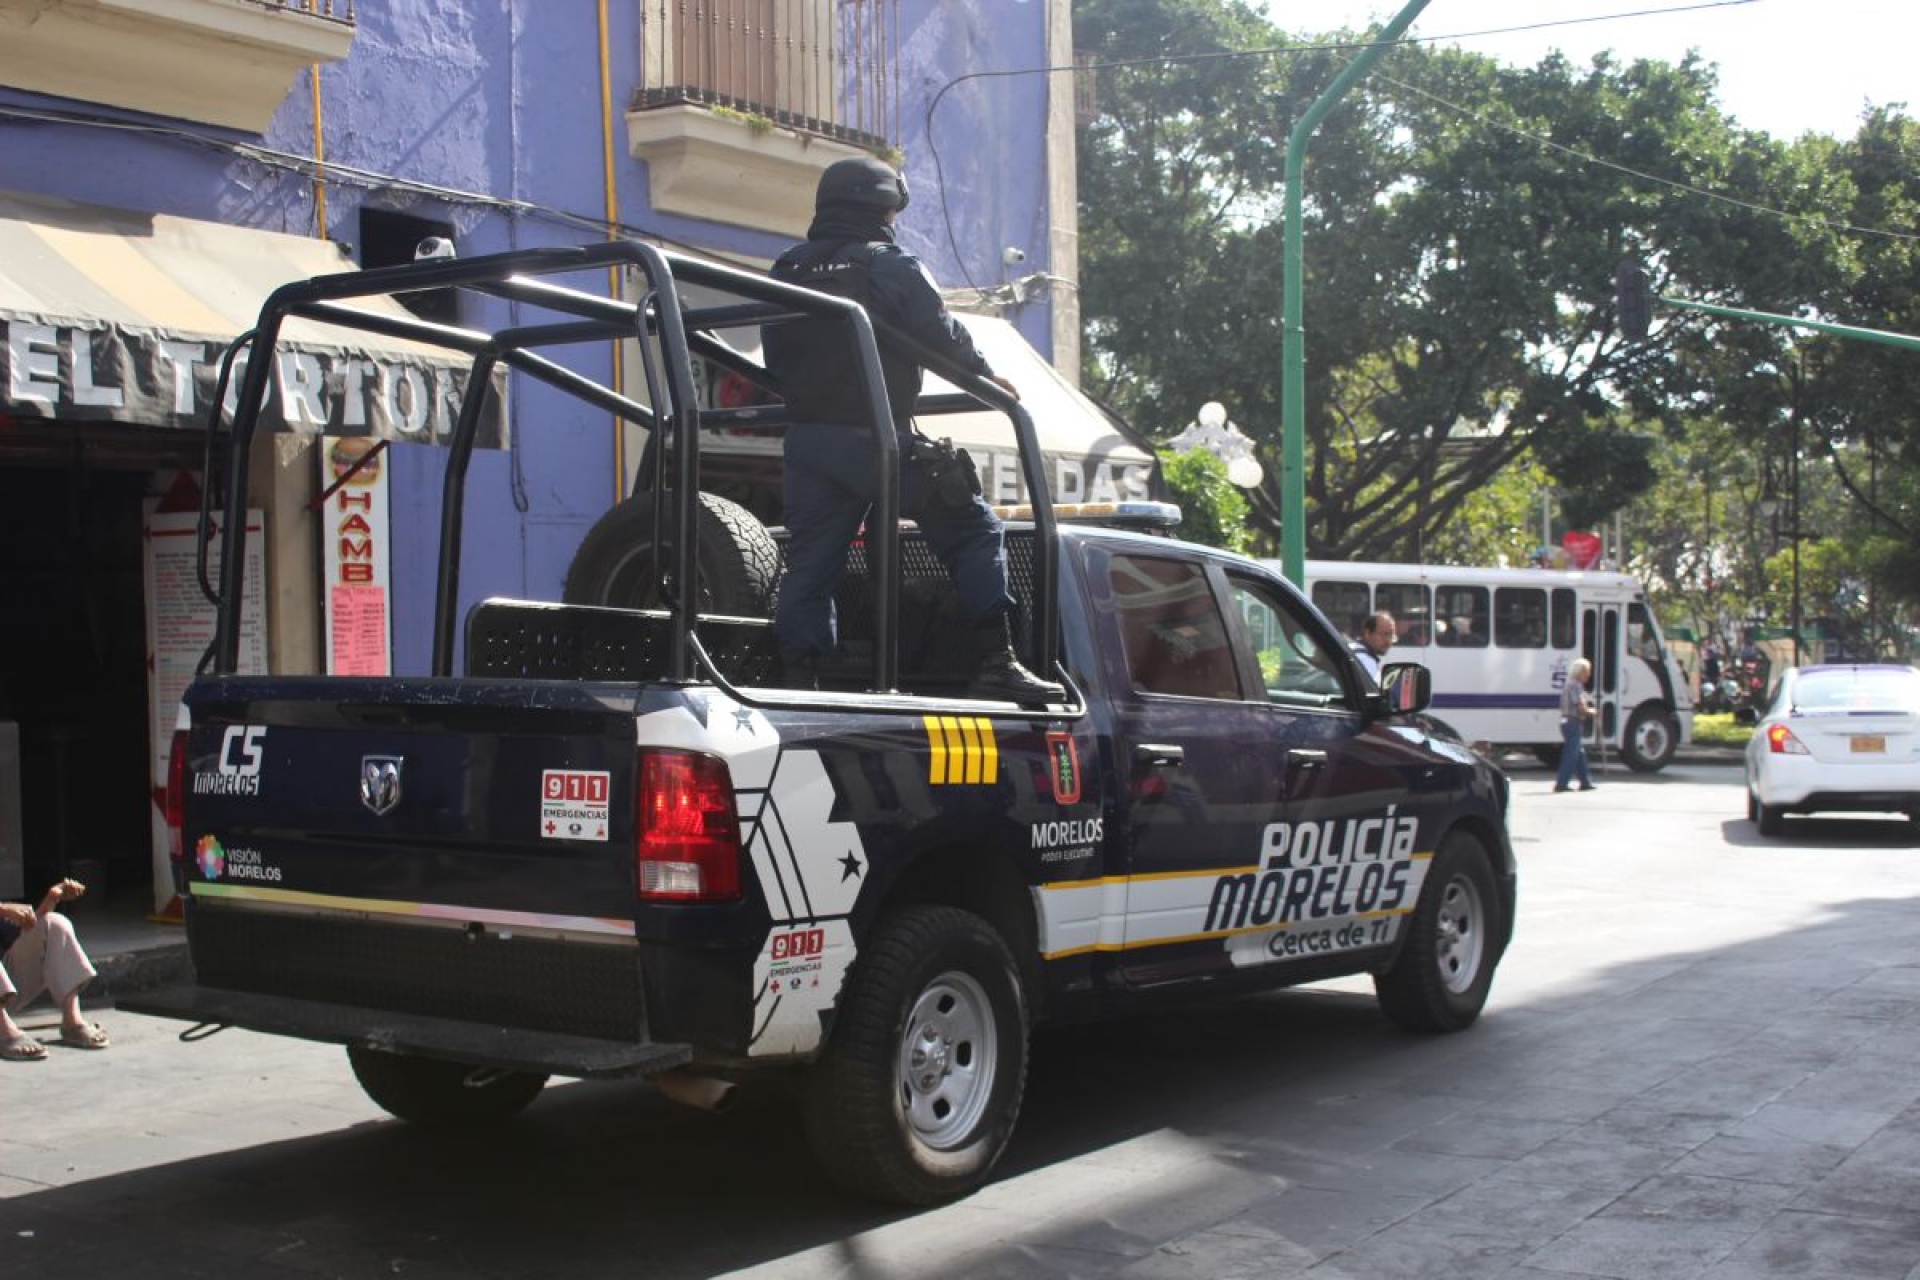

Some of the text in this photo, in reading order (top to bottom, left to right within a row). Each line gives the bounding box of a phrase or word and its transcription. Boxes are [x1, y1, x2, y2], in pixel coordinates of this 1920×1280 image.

[8, 322, 123, 407] EL
[548, 777, 604, 799] 911
[543, 809, 607, 820] EMERGENCIAS
[1031, 819, 1103, 849] MORELOS
[228, 863, 283, 881] MORELOS
[1203, 860, 1412, 932] MORELOS
[774, 932, 821, 957] 911
[1268, 930, 1332, 957] Cerca
[1335, 921, 1365, 947] de
